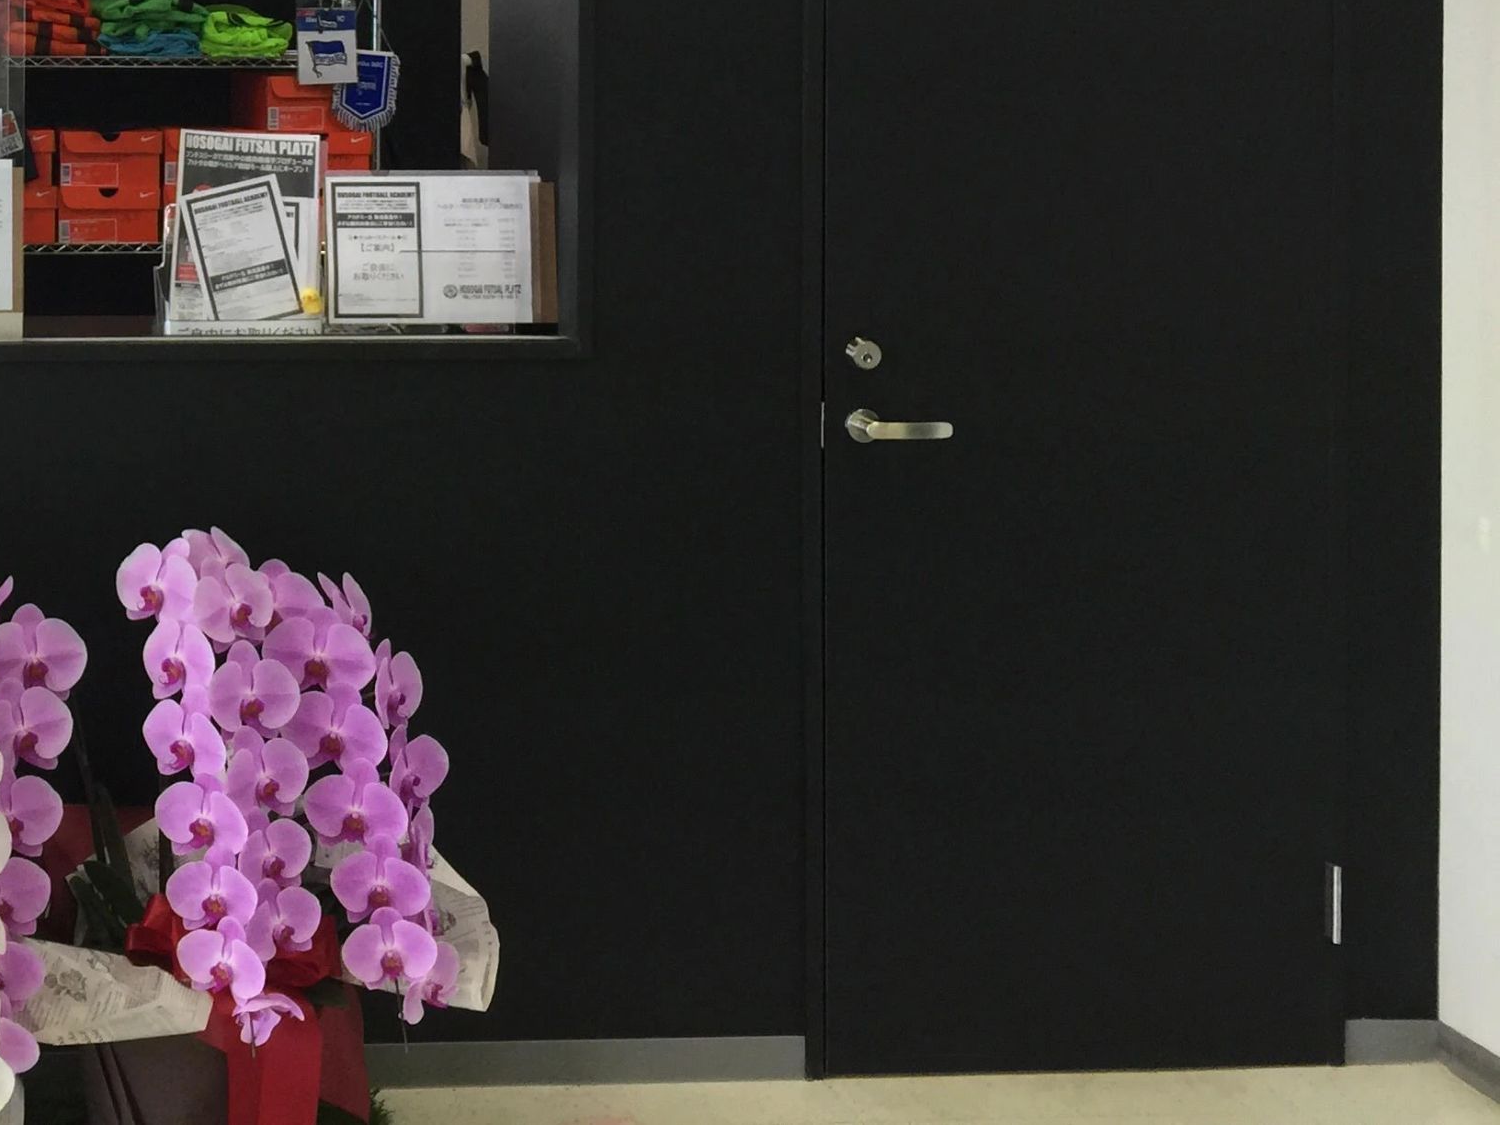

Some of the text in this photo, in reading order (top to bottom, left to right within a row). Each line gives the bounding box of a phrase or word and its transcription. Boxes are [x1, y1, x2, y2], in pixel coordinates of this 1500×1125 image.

[185, 134, 315, 156] HOSOGAI FUTSAL PLATZ
